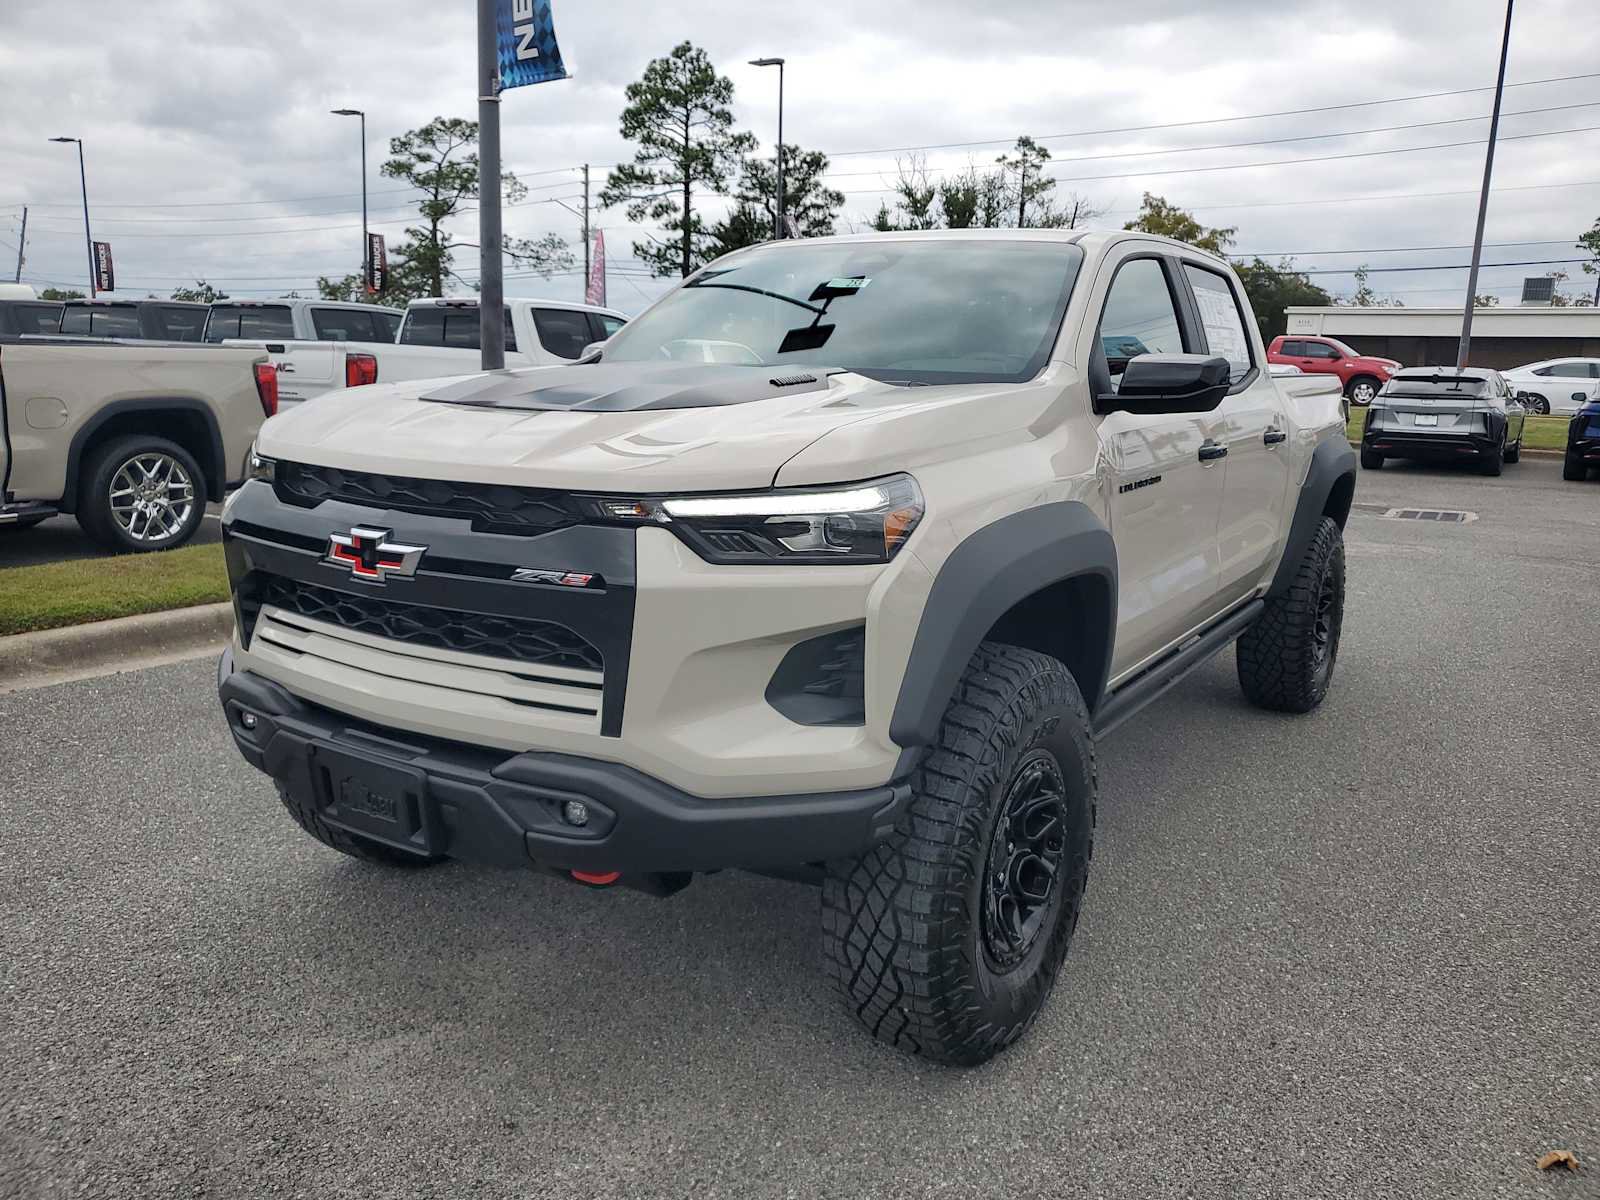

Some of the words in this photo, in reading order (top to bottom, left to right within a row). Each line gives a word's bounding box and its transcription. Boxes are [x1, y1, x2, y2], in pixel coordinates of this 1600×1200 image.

[373, 236, 382, 269] TRUCKS
[373, 270, 382, 290] NEW
[510, 567, 593, 587] ZR2
